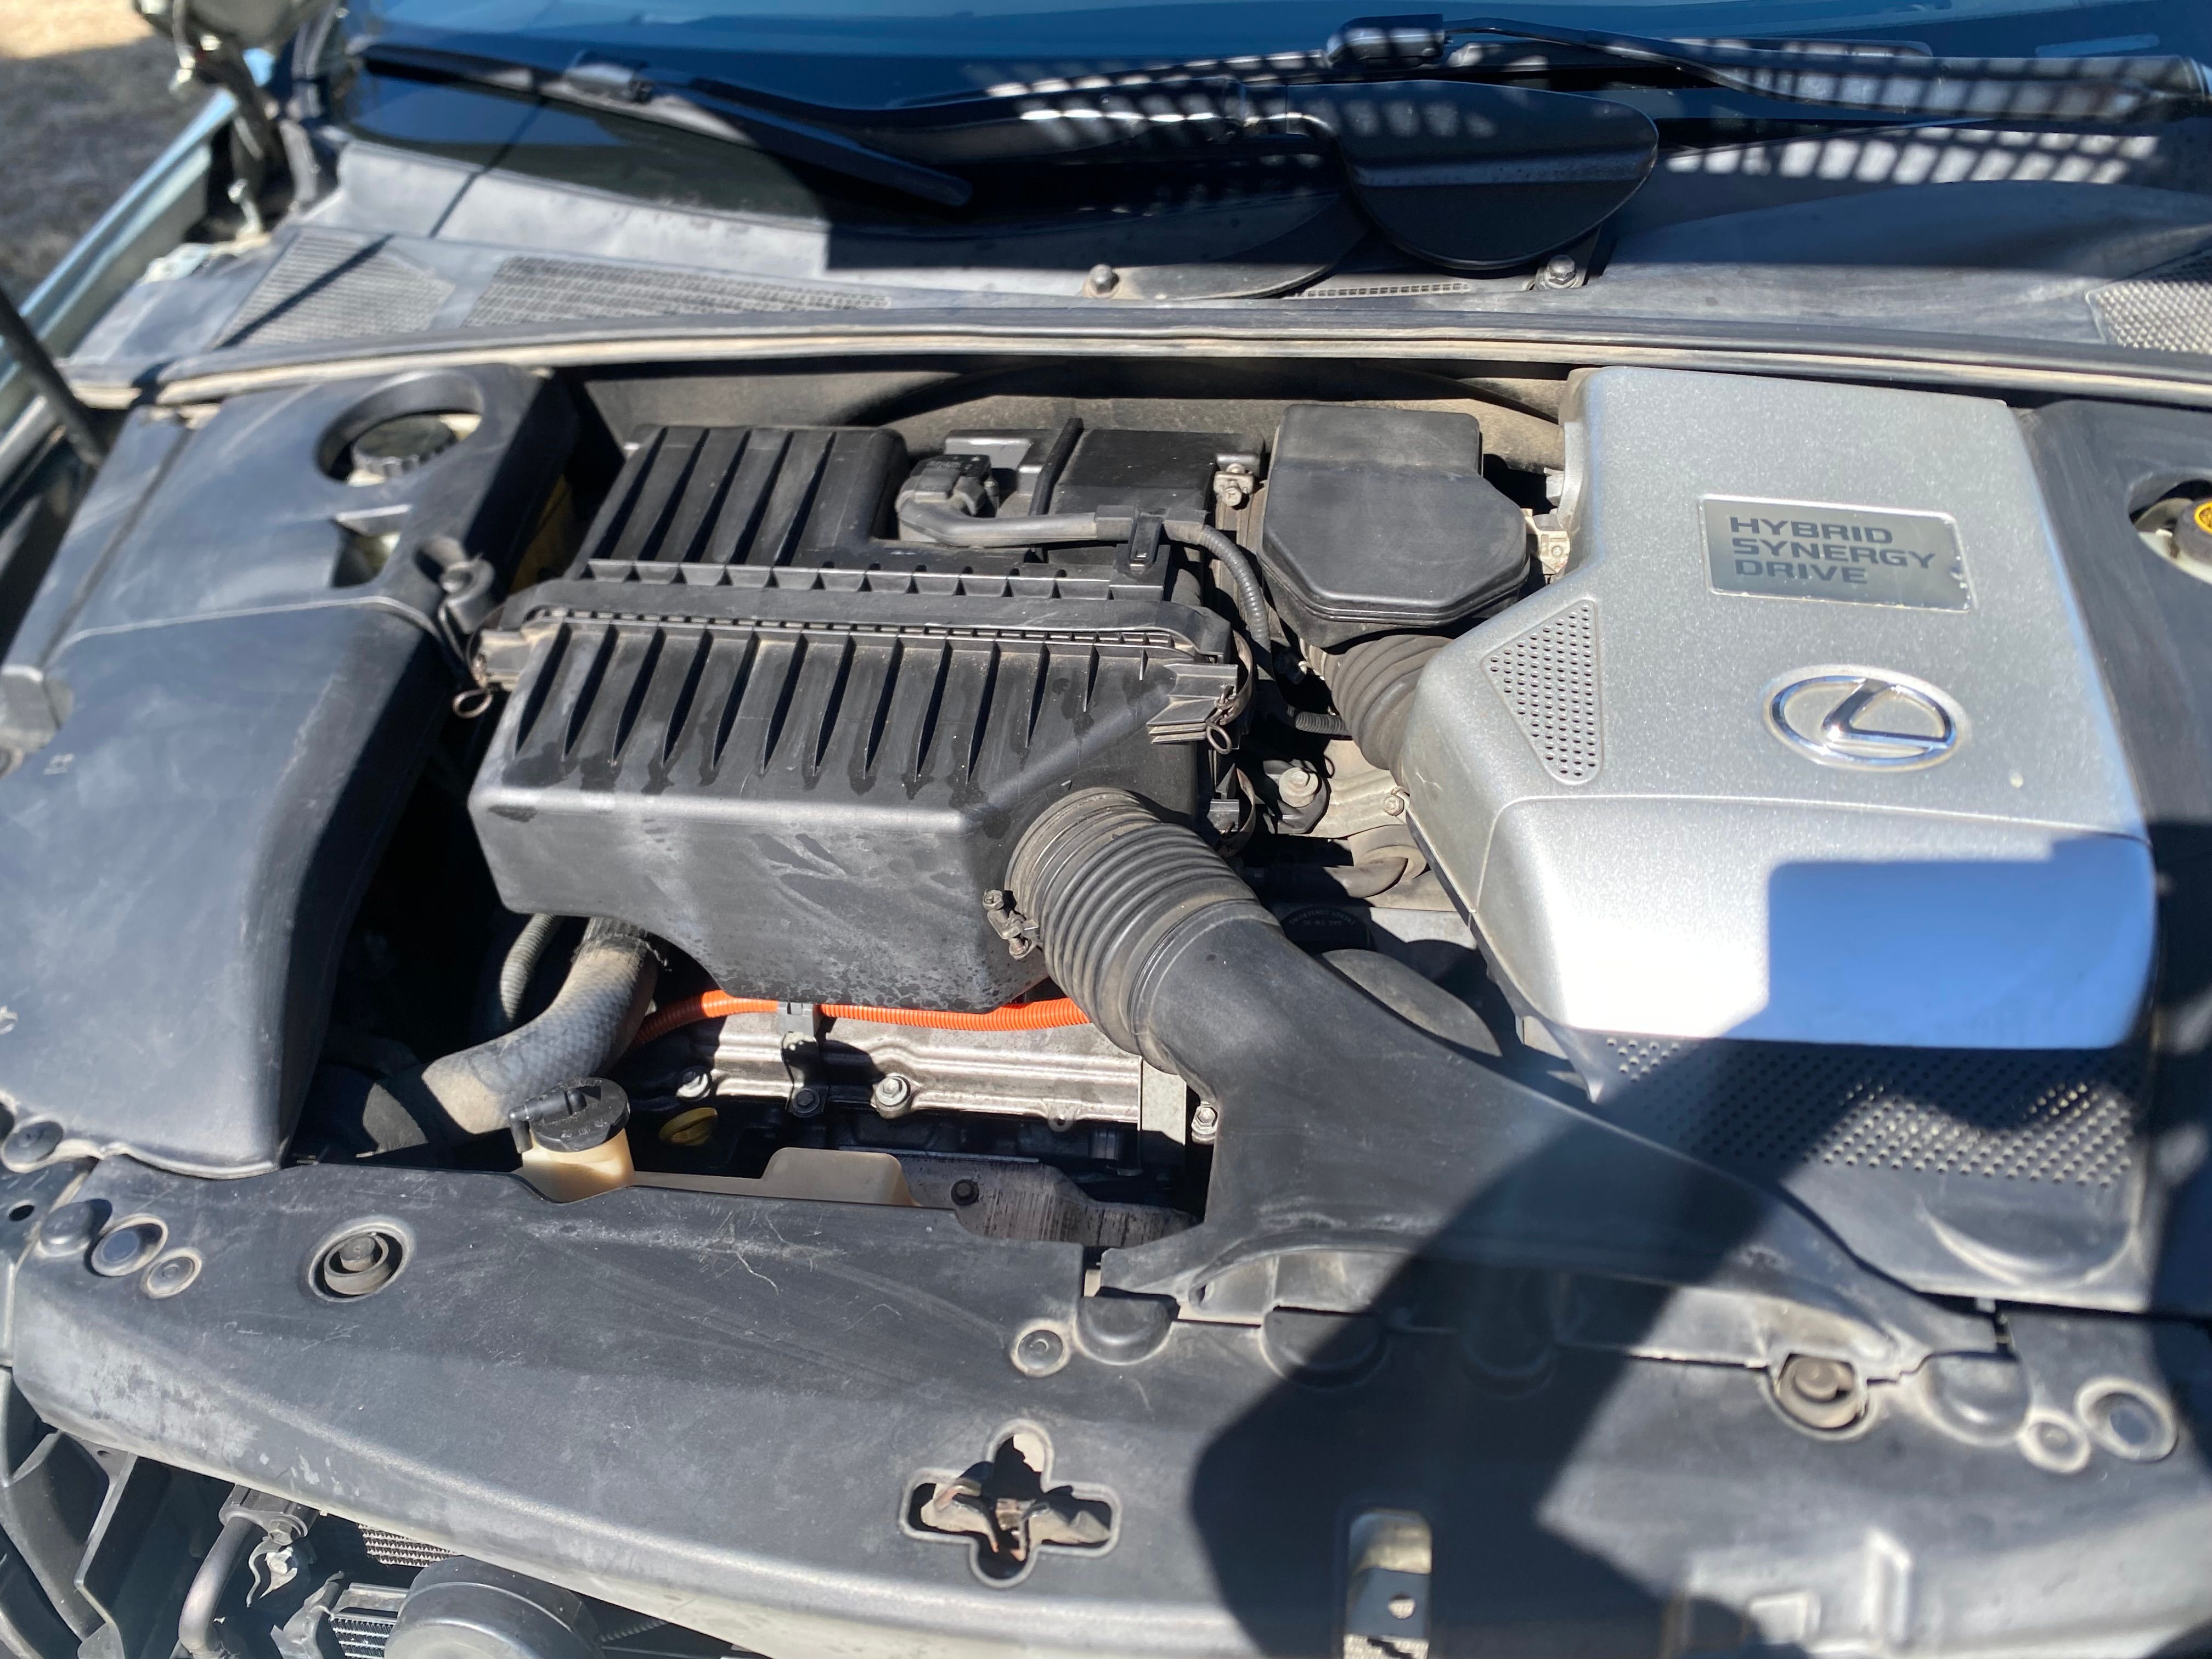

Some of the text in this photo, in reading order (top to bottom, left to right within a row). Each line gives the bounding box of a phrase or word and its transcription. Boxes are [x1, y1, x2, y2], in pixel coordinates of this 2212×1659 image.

[1730, 516, 1893, 544] HYBRID
[1733, 537, 1936, 568] SYNERGY
[1736, 558, 1868, 584] DRIVE
